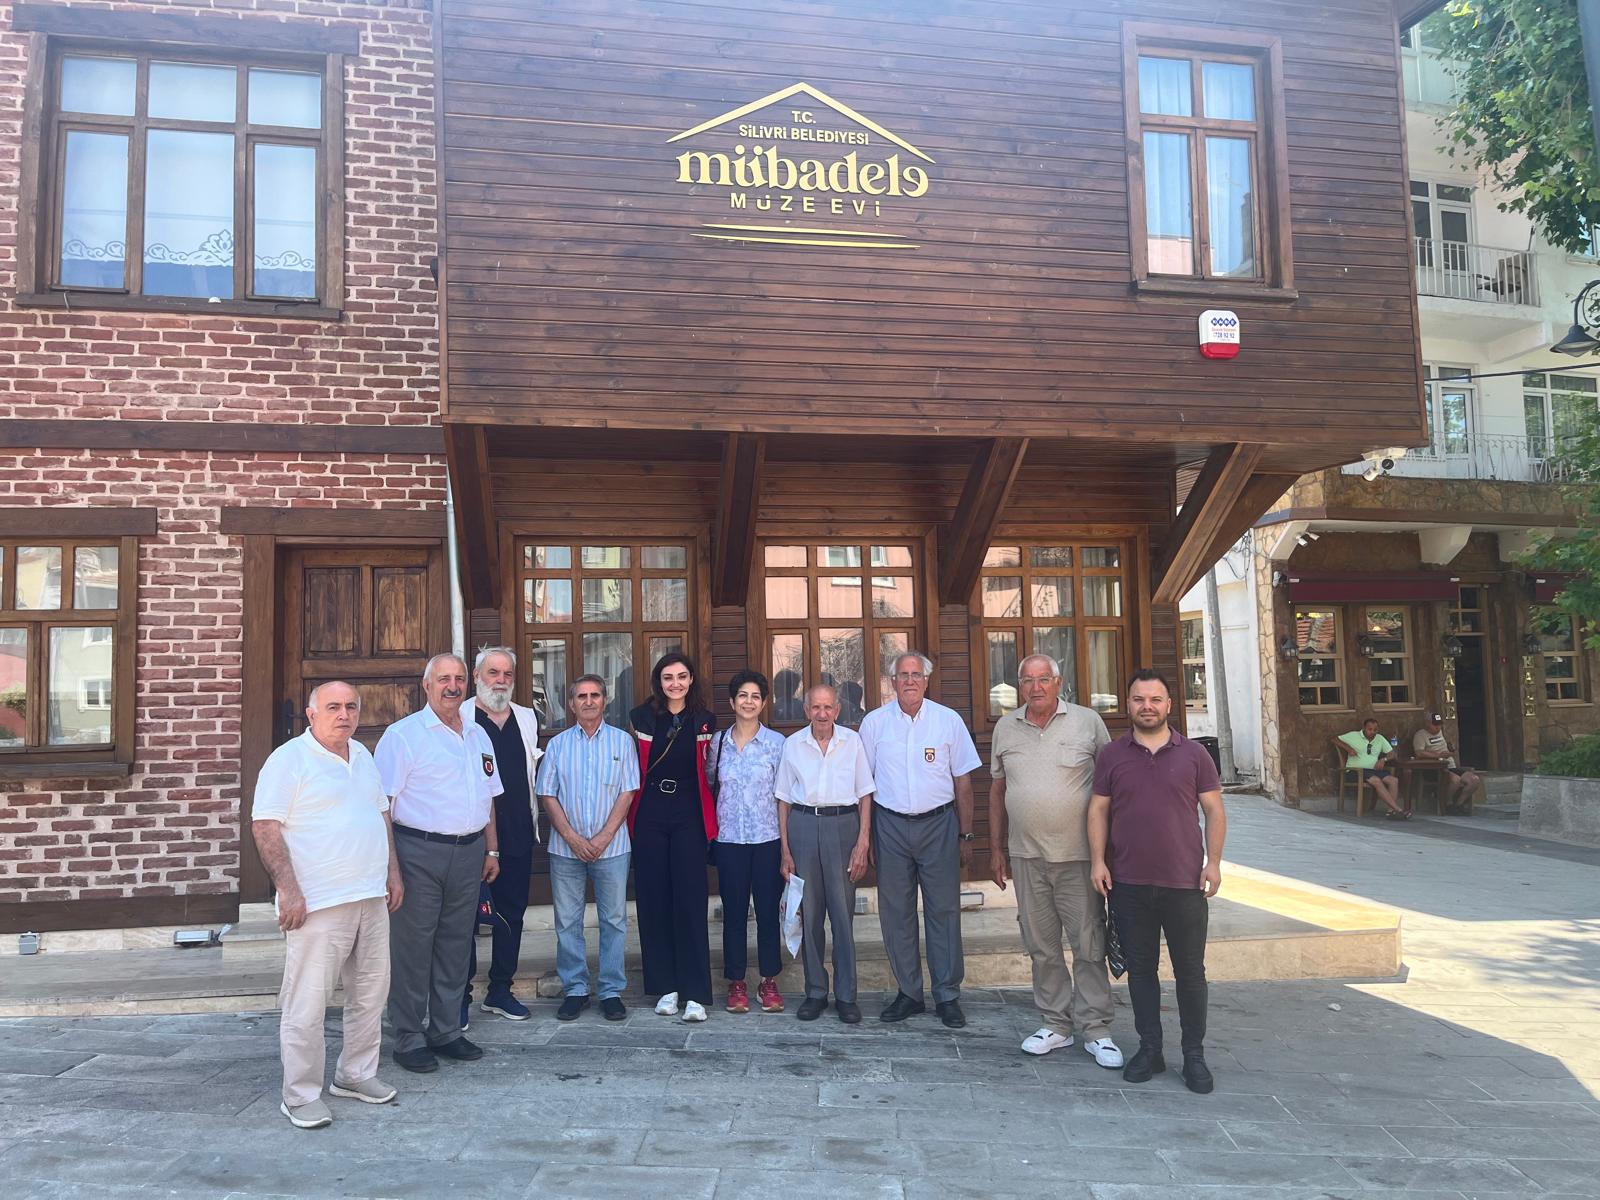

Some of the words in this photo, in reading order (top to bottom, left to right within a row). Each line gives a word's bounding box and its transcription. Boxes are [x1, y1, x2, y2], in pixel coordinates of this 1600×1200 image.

[791, 111, 817, 124] T.C.
[739, 124, 787, 140] SİLİVRİ
[1443, 657, 1456, 720] KALE
